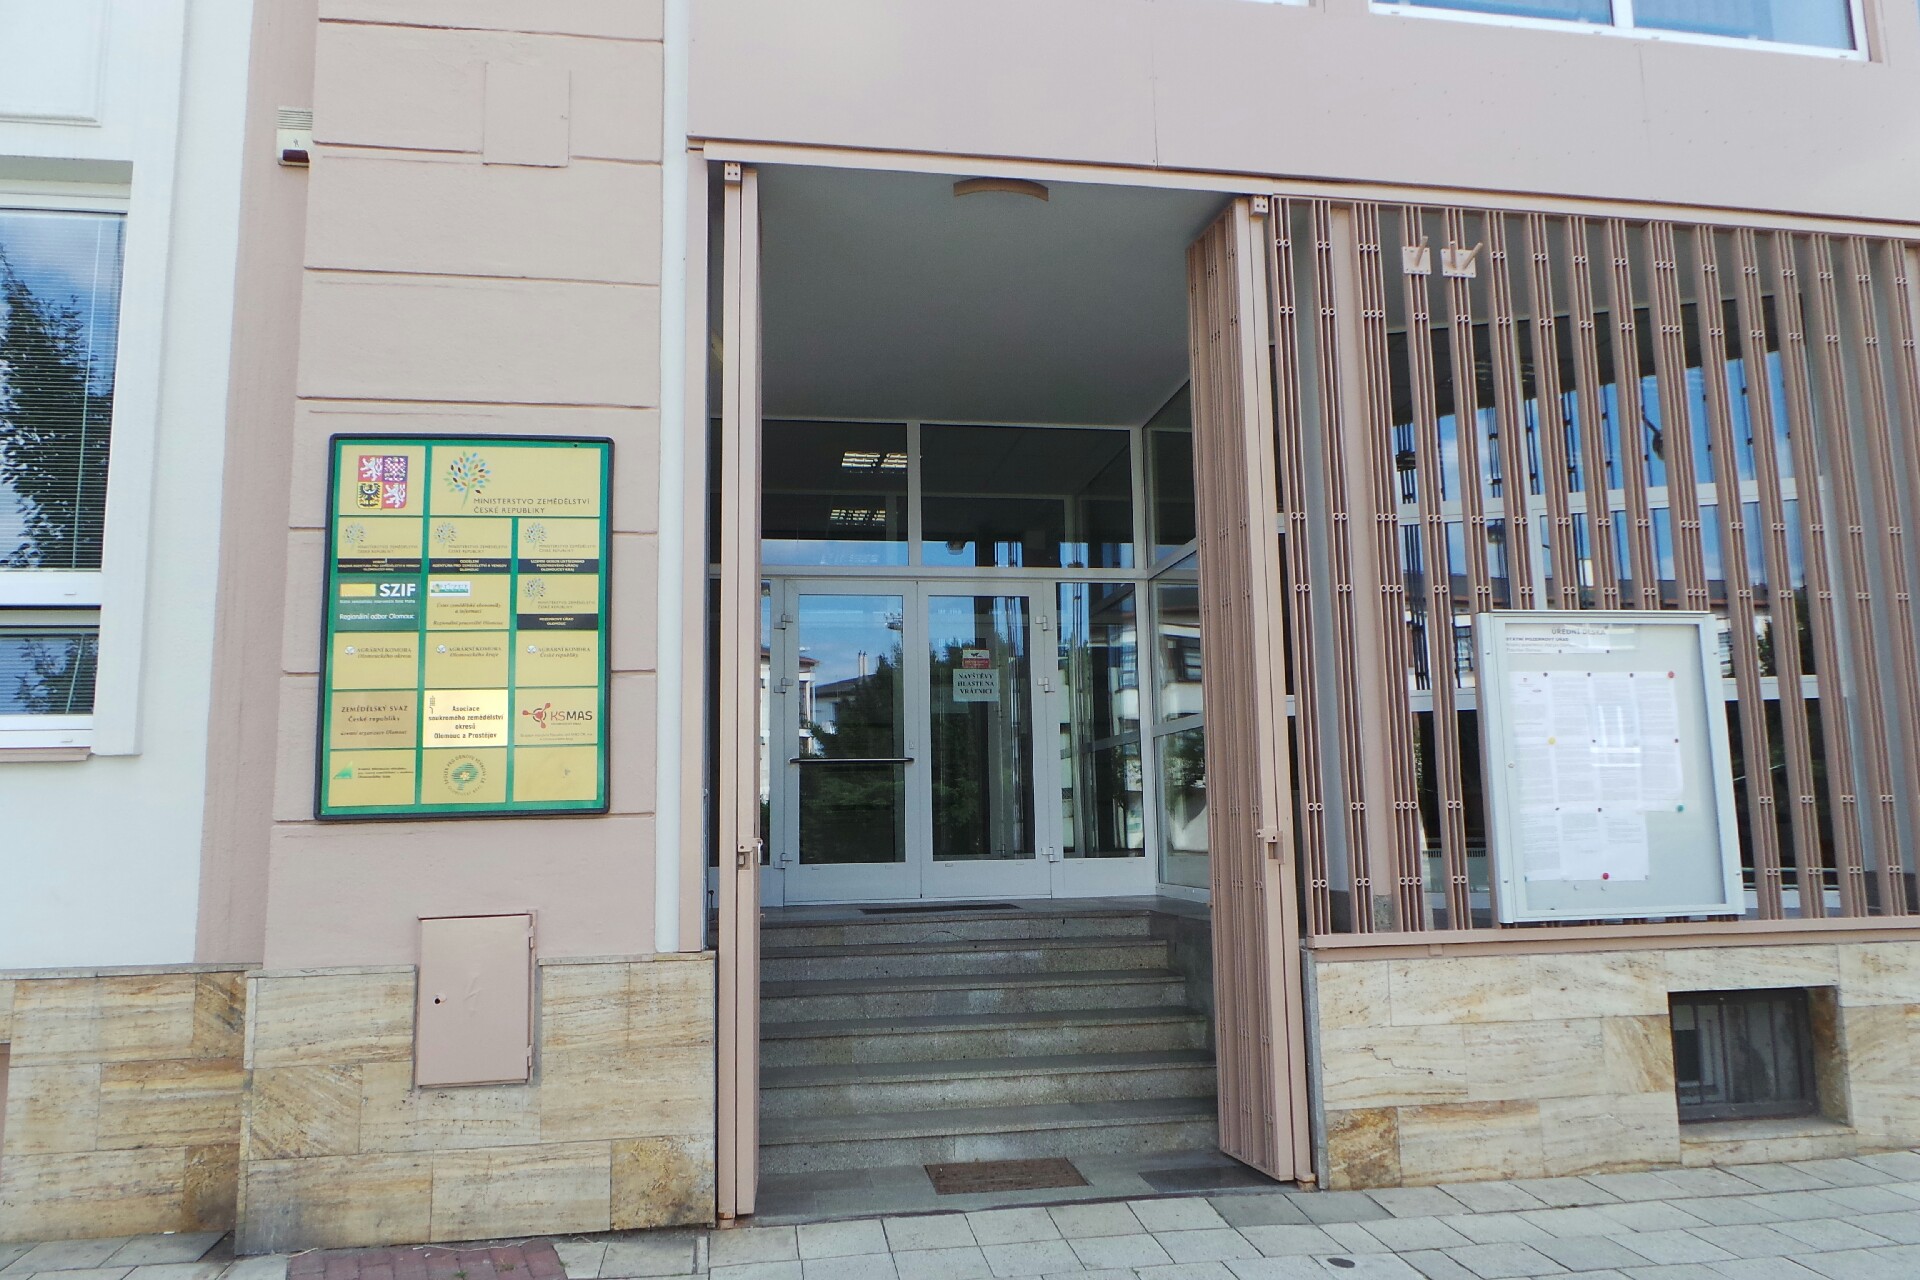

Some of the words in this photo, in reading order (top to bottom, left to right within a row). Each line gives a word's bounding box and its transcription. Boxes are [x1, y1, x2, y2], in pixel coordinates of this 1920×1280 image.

[537, 497, 590, 505] ZEMĚDĚLSTVÍ
[379, 583, 416, 597] SZIF
[341, 705, 387, 713] ZEMĚDĚLSKÝ
[550, 710, 593, 721] KSMAS
